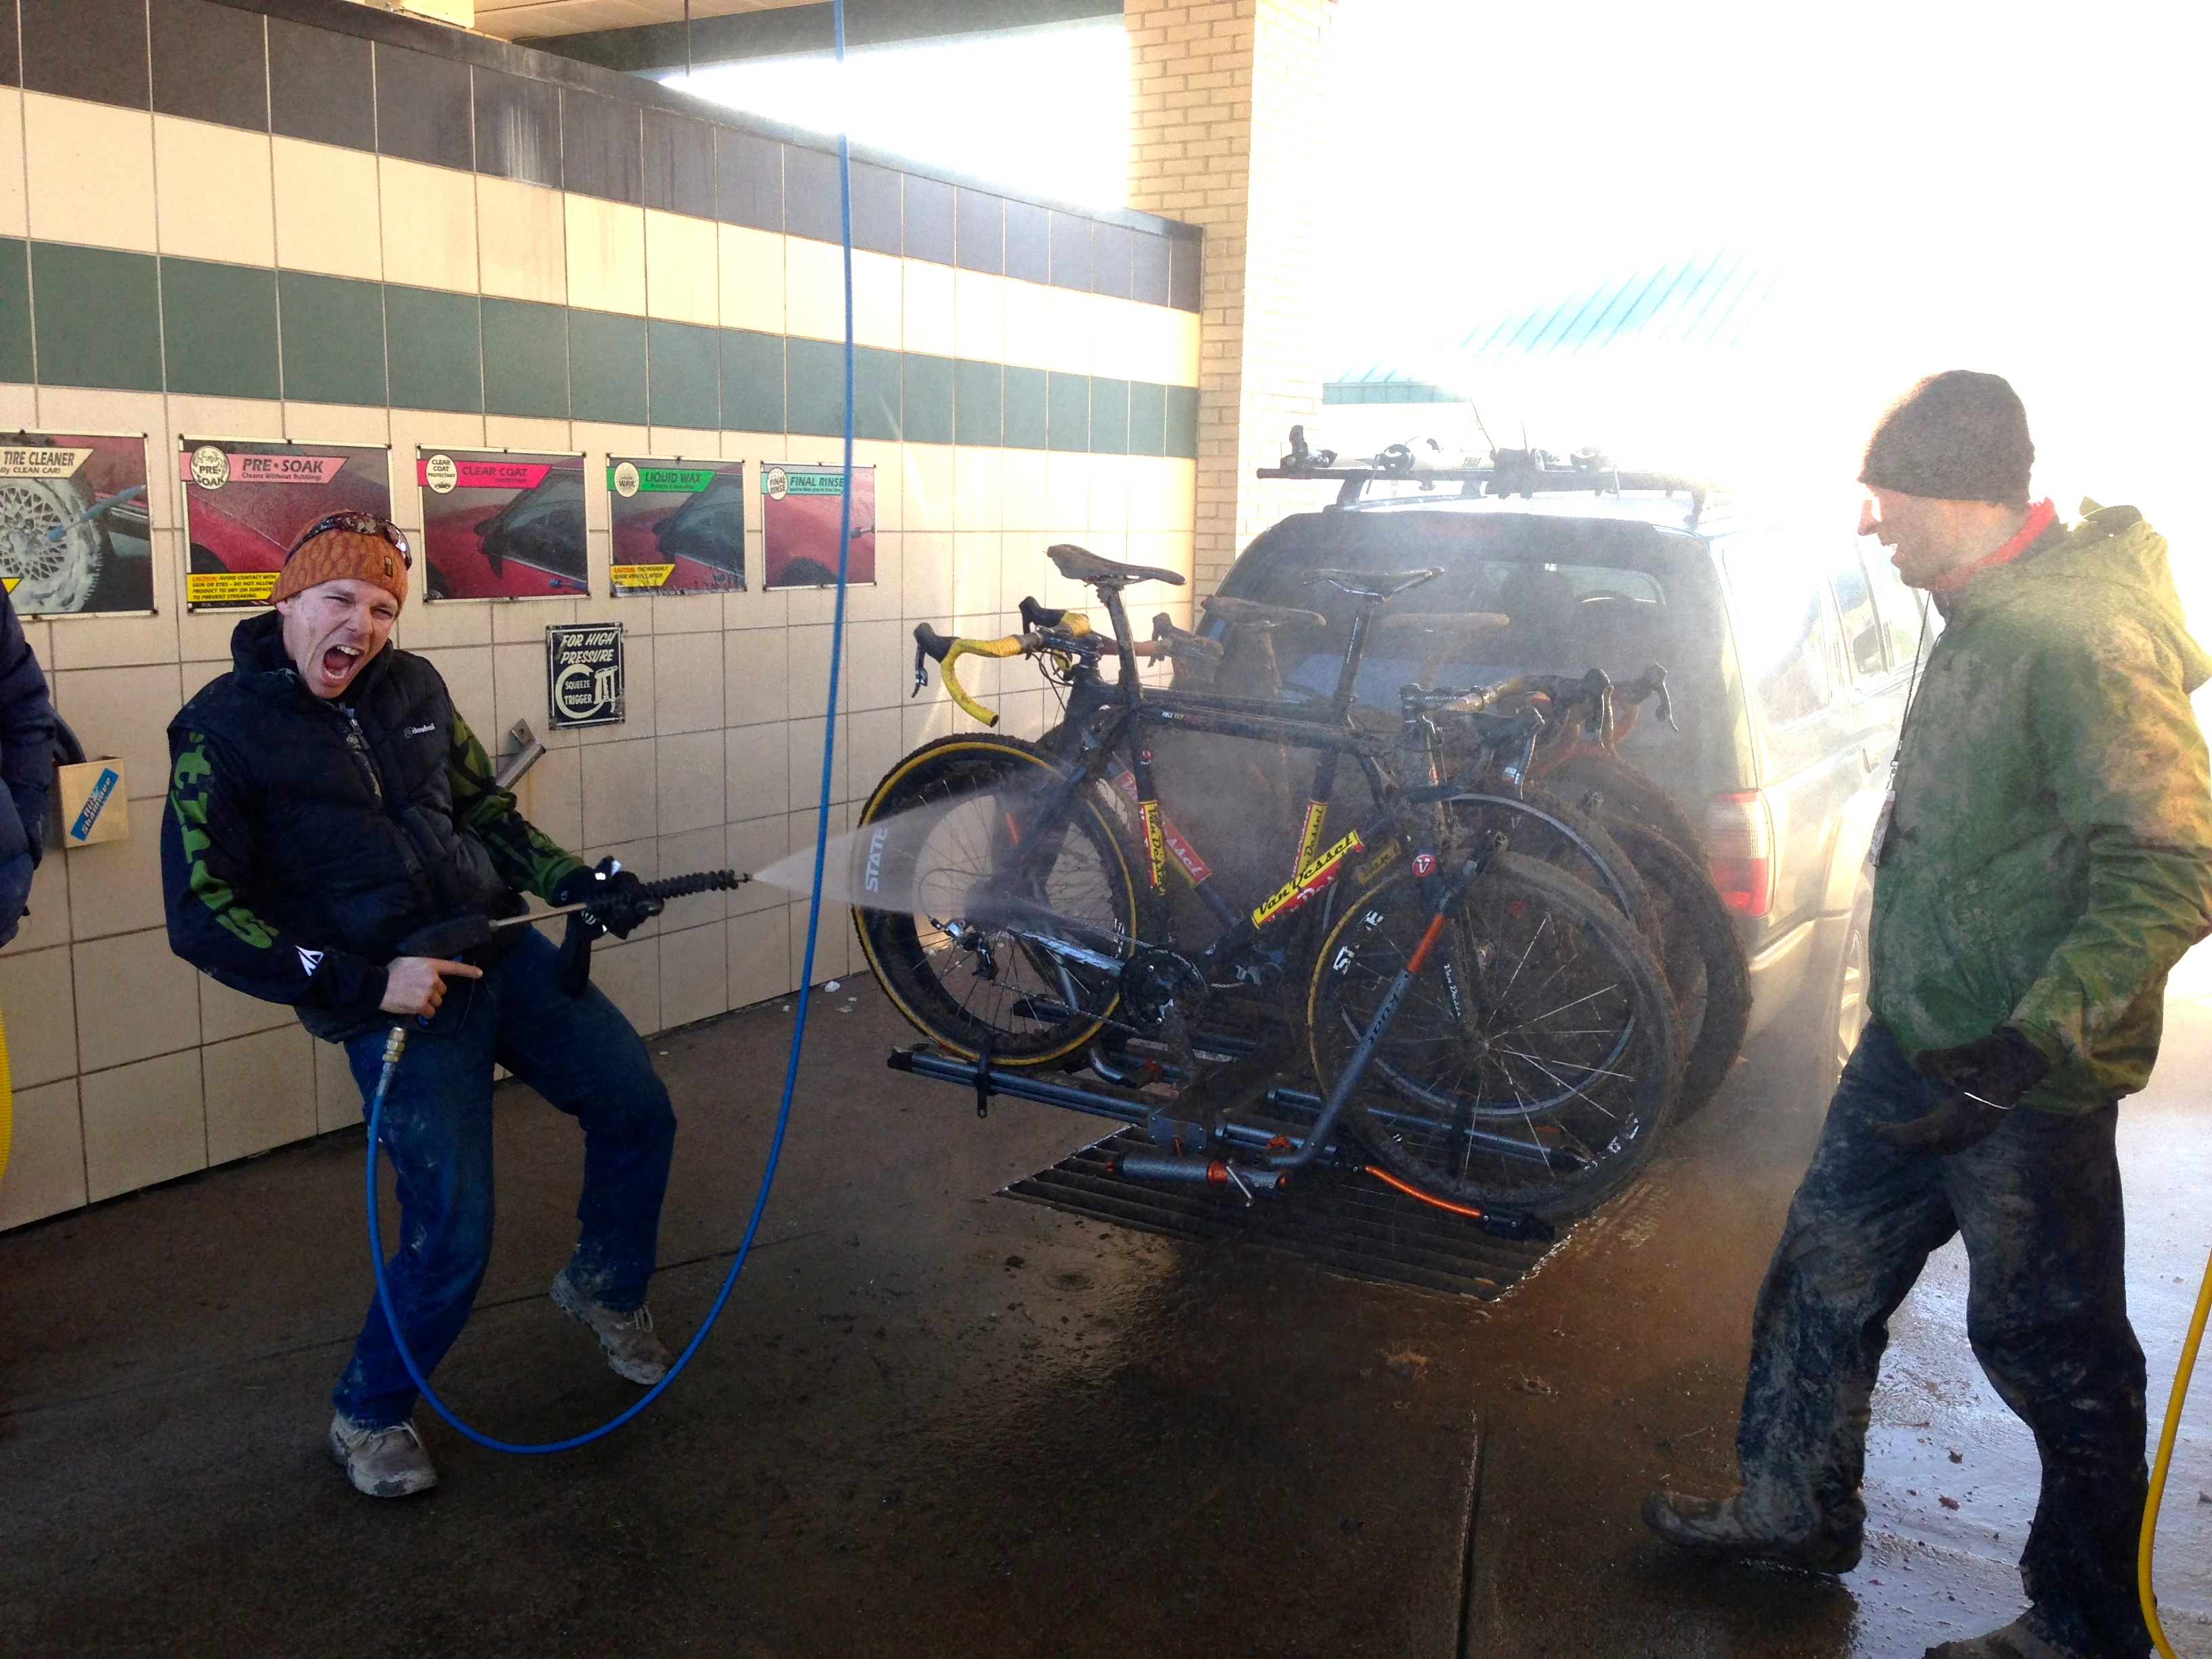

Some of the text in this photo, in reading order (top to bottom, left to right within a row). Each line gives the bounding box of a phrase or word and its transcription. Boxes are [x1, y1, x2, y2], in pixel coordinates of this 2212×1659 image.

[4, 451, 75, 466] TIRE CLEANER
[242, 458, 324, 473] PRE SOAK
[462, 466, 528, 477] CLEAR COAT
[196, 474, 225, 487] SOAK
[645, 472, 702, 483] LIQUID WAX
[769, 476, 786, 487] FINAL
[790, 476, 844, 487] FINAL RINSE
[770, 485, 786, 495] RINSE
[560, 631, 617, 647] FOR HIGH
[560, 649, 615, 665] PRESSURE
[565, 680, 591, 690] SQUEEZE
[564, 693, 592, 705] TRIGGER
[1148, 806, 1160, 835] Van
[865, 827, 888, 893] STATE
[1259, 886, 1290, 916] Van
[1290, 834, 1353, 890] Dessel
